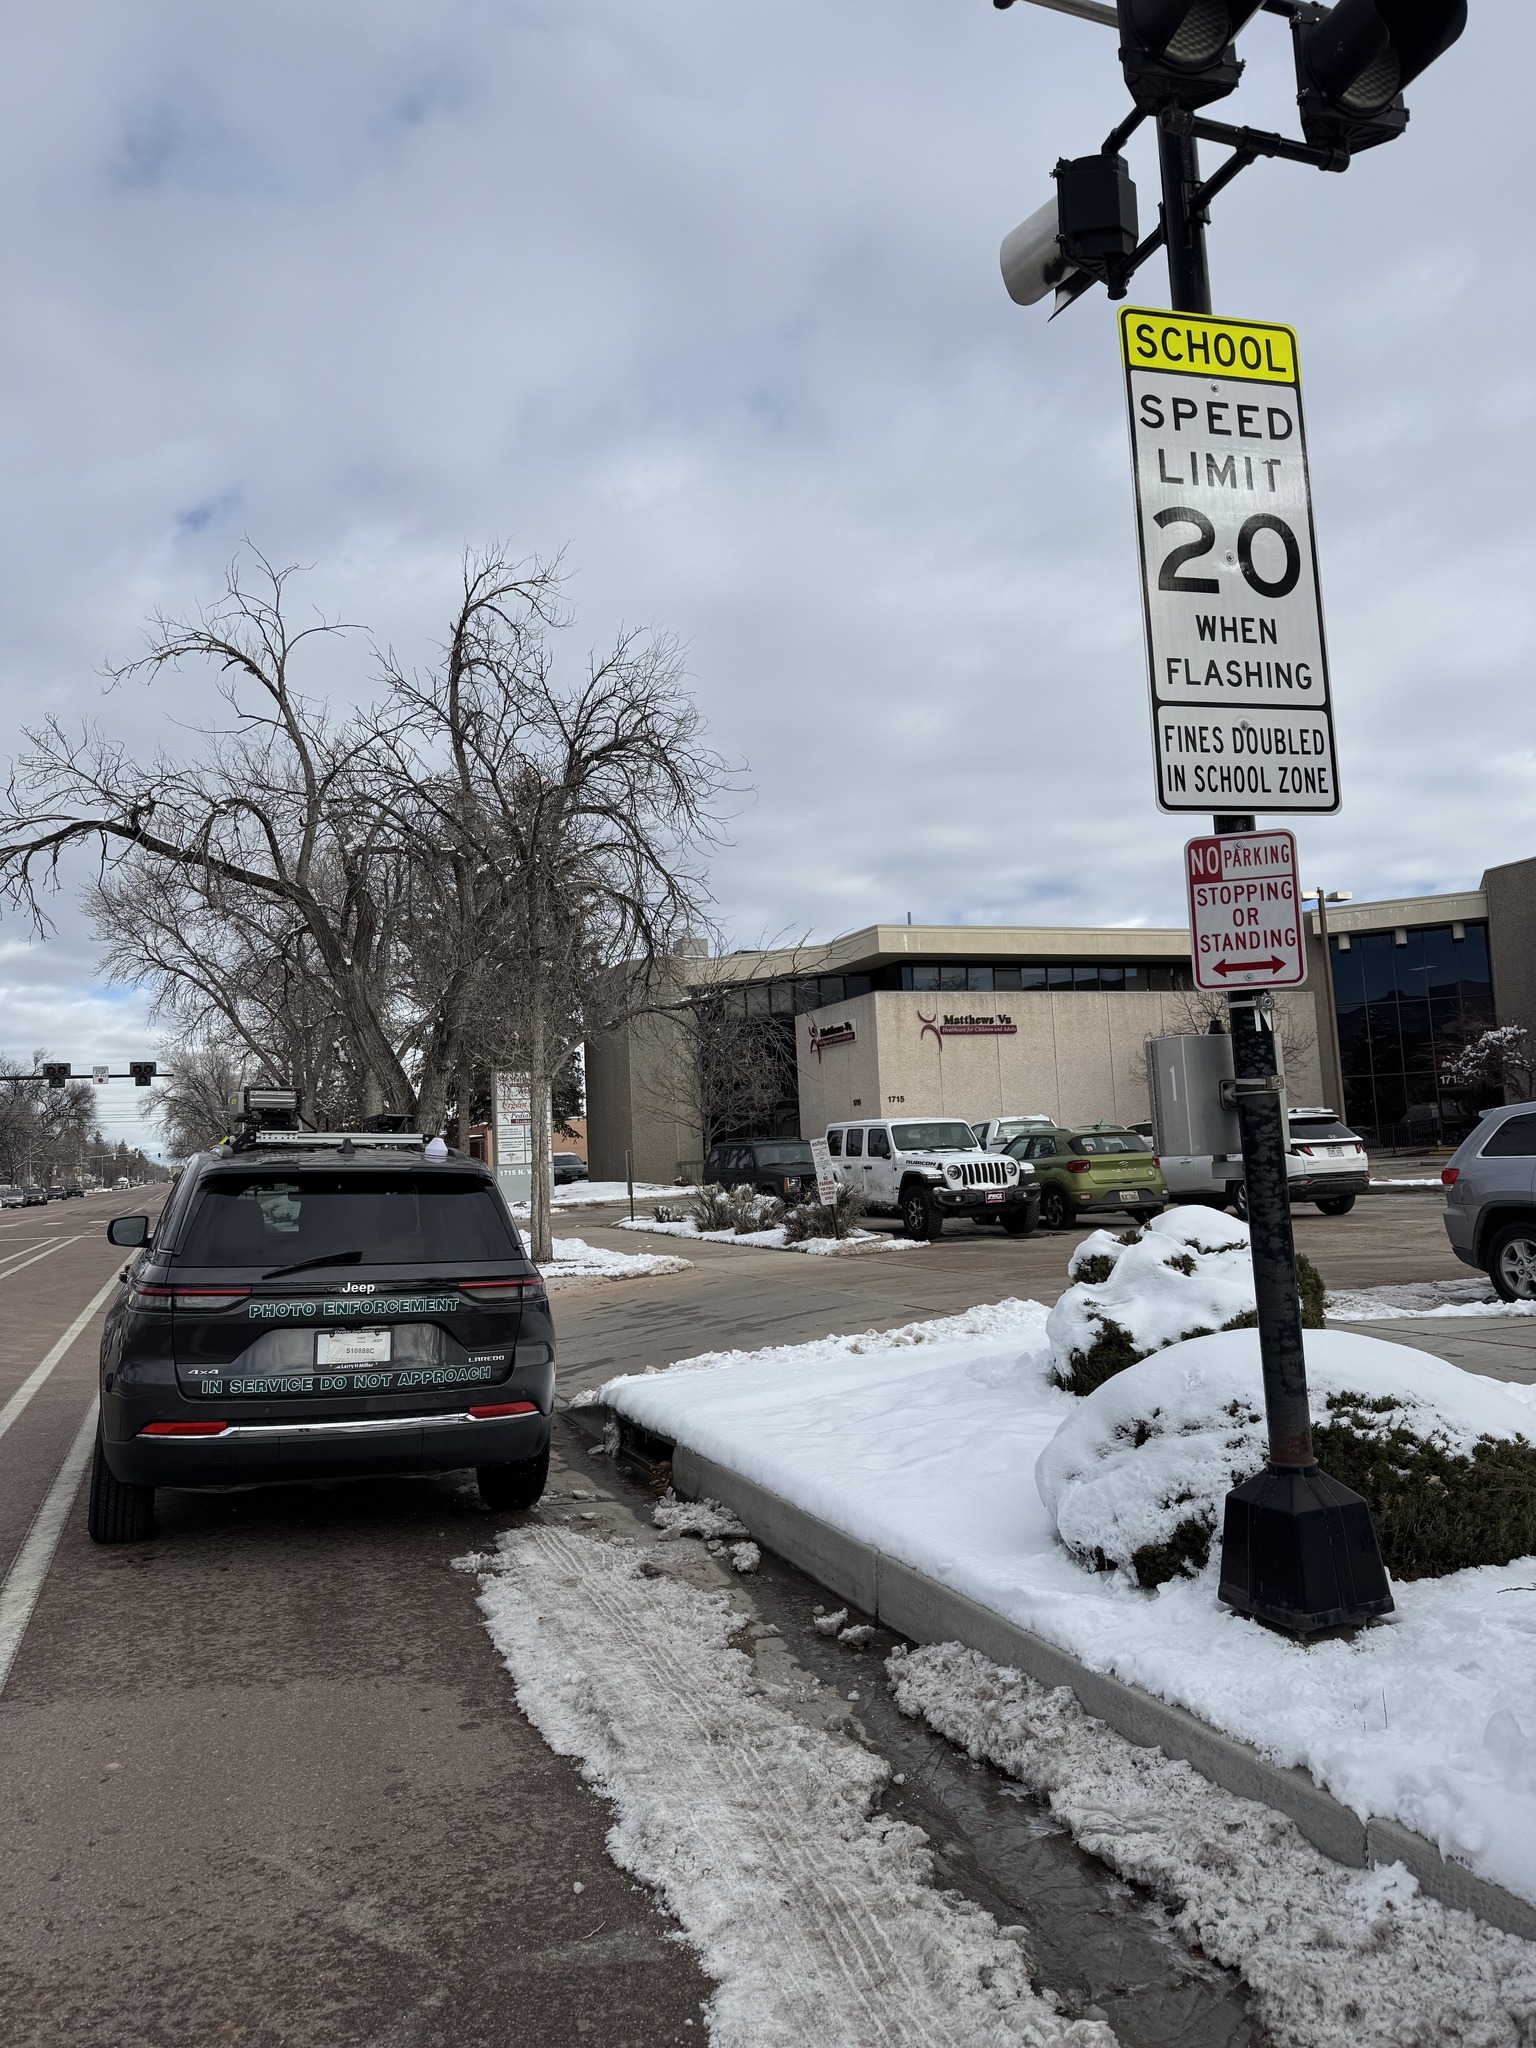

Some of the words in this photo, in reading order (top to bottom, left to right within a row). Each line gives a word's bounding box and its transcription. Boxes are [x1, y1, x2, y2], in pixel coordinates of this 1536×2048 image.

[1136, 324, 1287, 373] SCHOOL
[1140, 394, 1293, 440] SPEED
[1158, 448, 1281, 492] LIMIT
[1152, 506, 1301, 599] 20
[1195, 614, 1278, 645] WHEN
[1166, 658, 1312, 690] FLASHING
[1164, 725, 1224, 754] FINES
[1232, 726, 1325, 755] DOUBLED
[1167, 764, 1186, 792] IN
[1194, 764, 1272, 793] SCHOOL
[1278, 766, 1329, 794] ZONE
[1190, 846, 1219, 876] NO
[1224, 844, 1290, 868] PARKING
[1197, 880, 1293, 906] STOPPING
[1232, 907, 1259, 927] OR
[1200, 928, 1296, 953] STANDING
[943, 1014, 994, 1025] Matthews
[997, 1014, 1012, 1025] Vu
[1169, 1065, 1177, 1102] 1
[888, 1095, 905, 1103] 1715
[342, 1282, 375, 1294] Jeep
[249, 1302, 316, 1318] PHOTO
[323, 1298, 459, 1315] ENFORCEMENT
[201, 1380, 222, 1394] IN
[229, 1376, 312, 1393] SERVICE
[320, 1375, 348, 1391] DO
[353, 1373, 393, 1389] NOT
[397, 1365, 492, 1386] APPROACH
